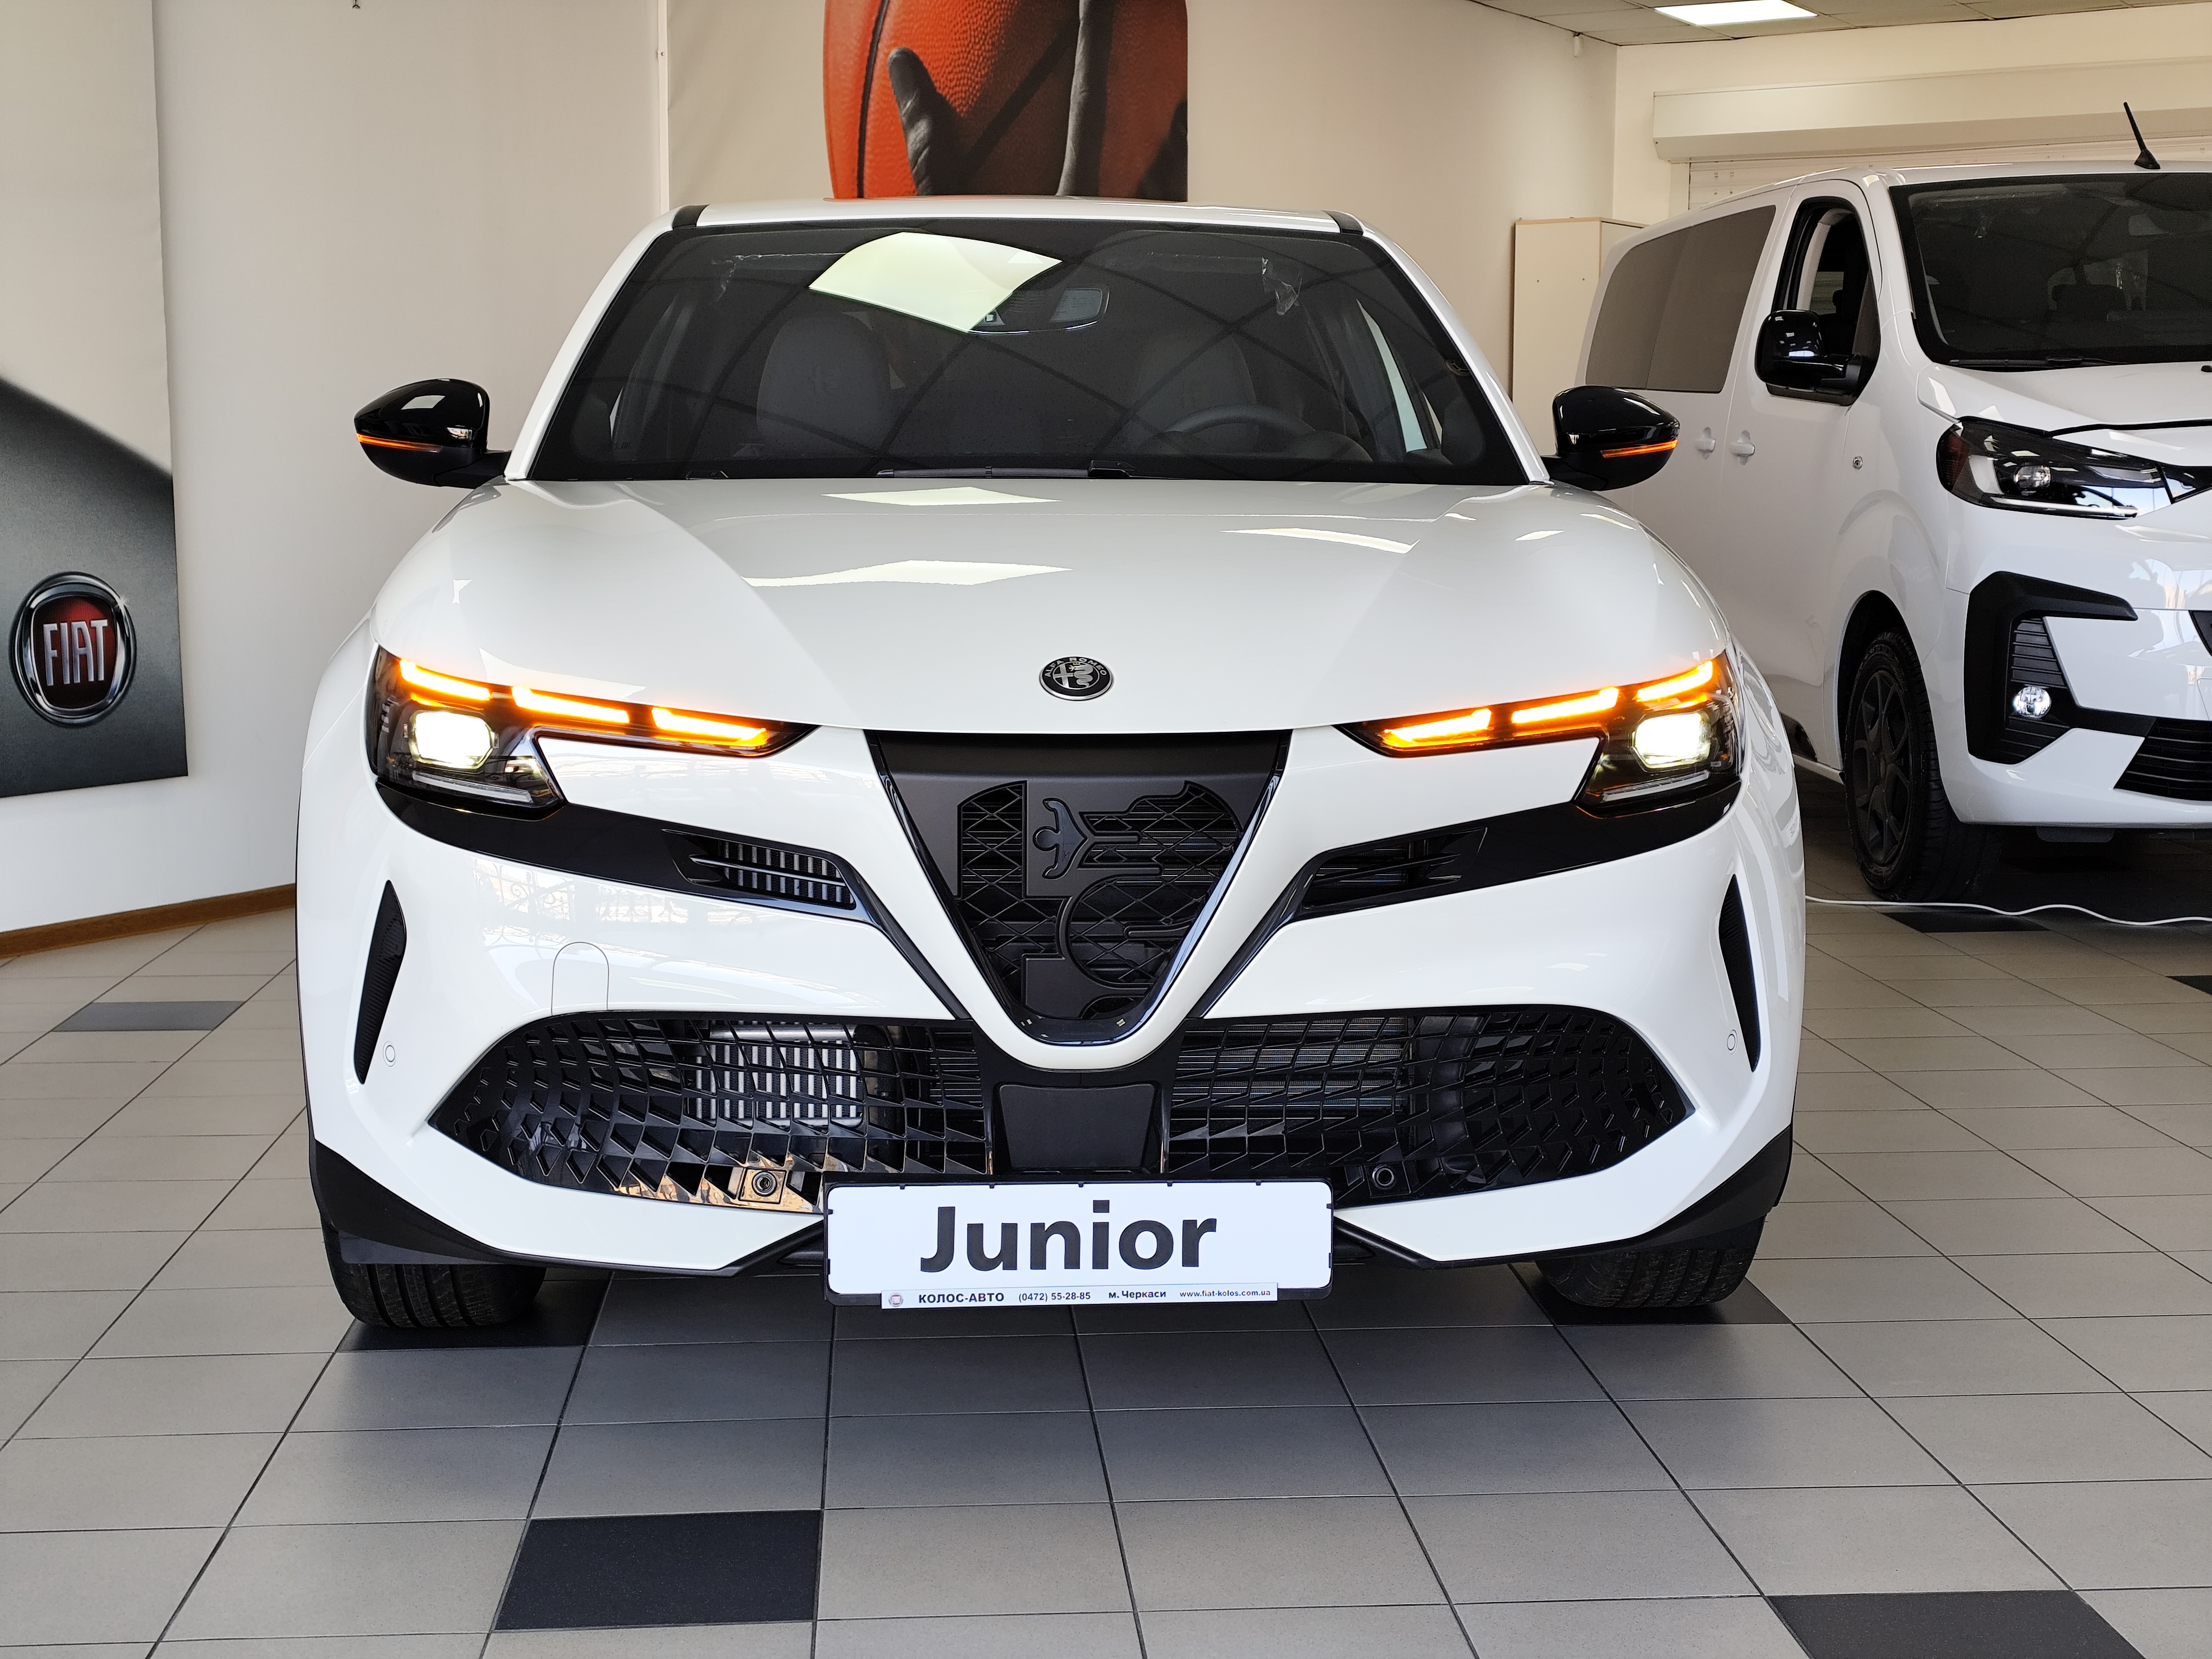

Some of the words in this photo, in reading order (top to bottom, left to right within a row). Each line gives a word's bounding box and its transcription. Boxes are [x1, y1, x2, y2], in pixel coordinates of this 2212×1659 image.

[43, 619, 108, 686] FIAT
[1044, 660, 1064, 678] ALFA
[1069, 657, 1108, 676] ROMEO
[920, 1199, 1217, 1273] Junior
[918, 1293, 1005, 1303] КОЛОС-АВТО
[1019, 1293, 1048, 1302] (0472)
[1051, 1292, 1091, 1301] 55-28-85
[1122, 1290, 1166, 1300] Черкаси
